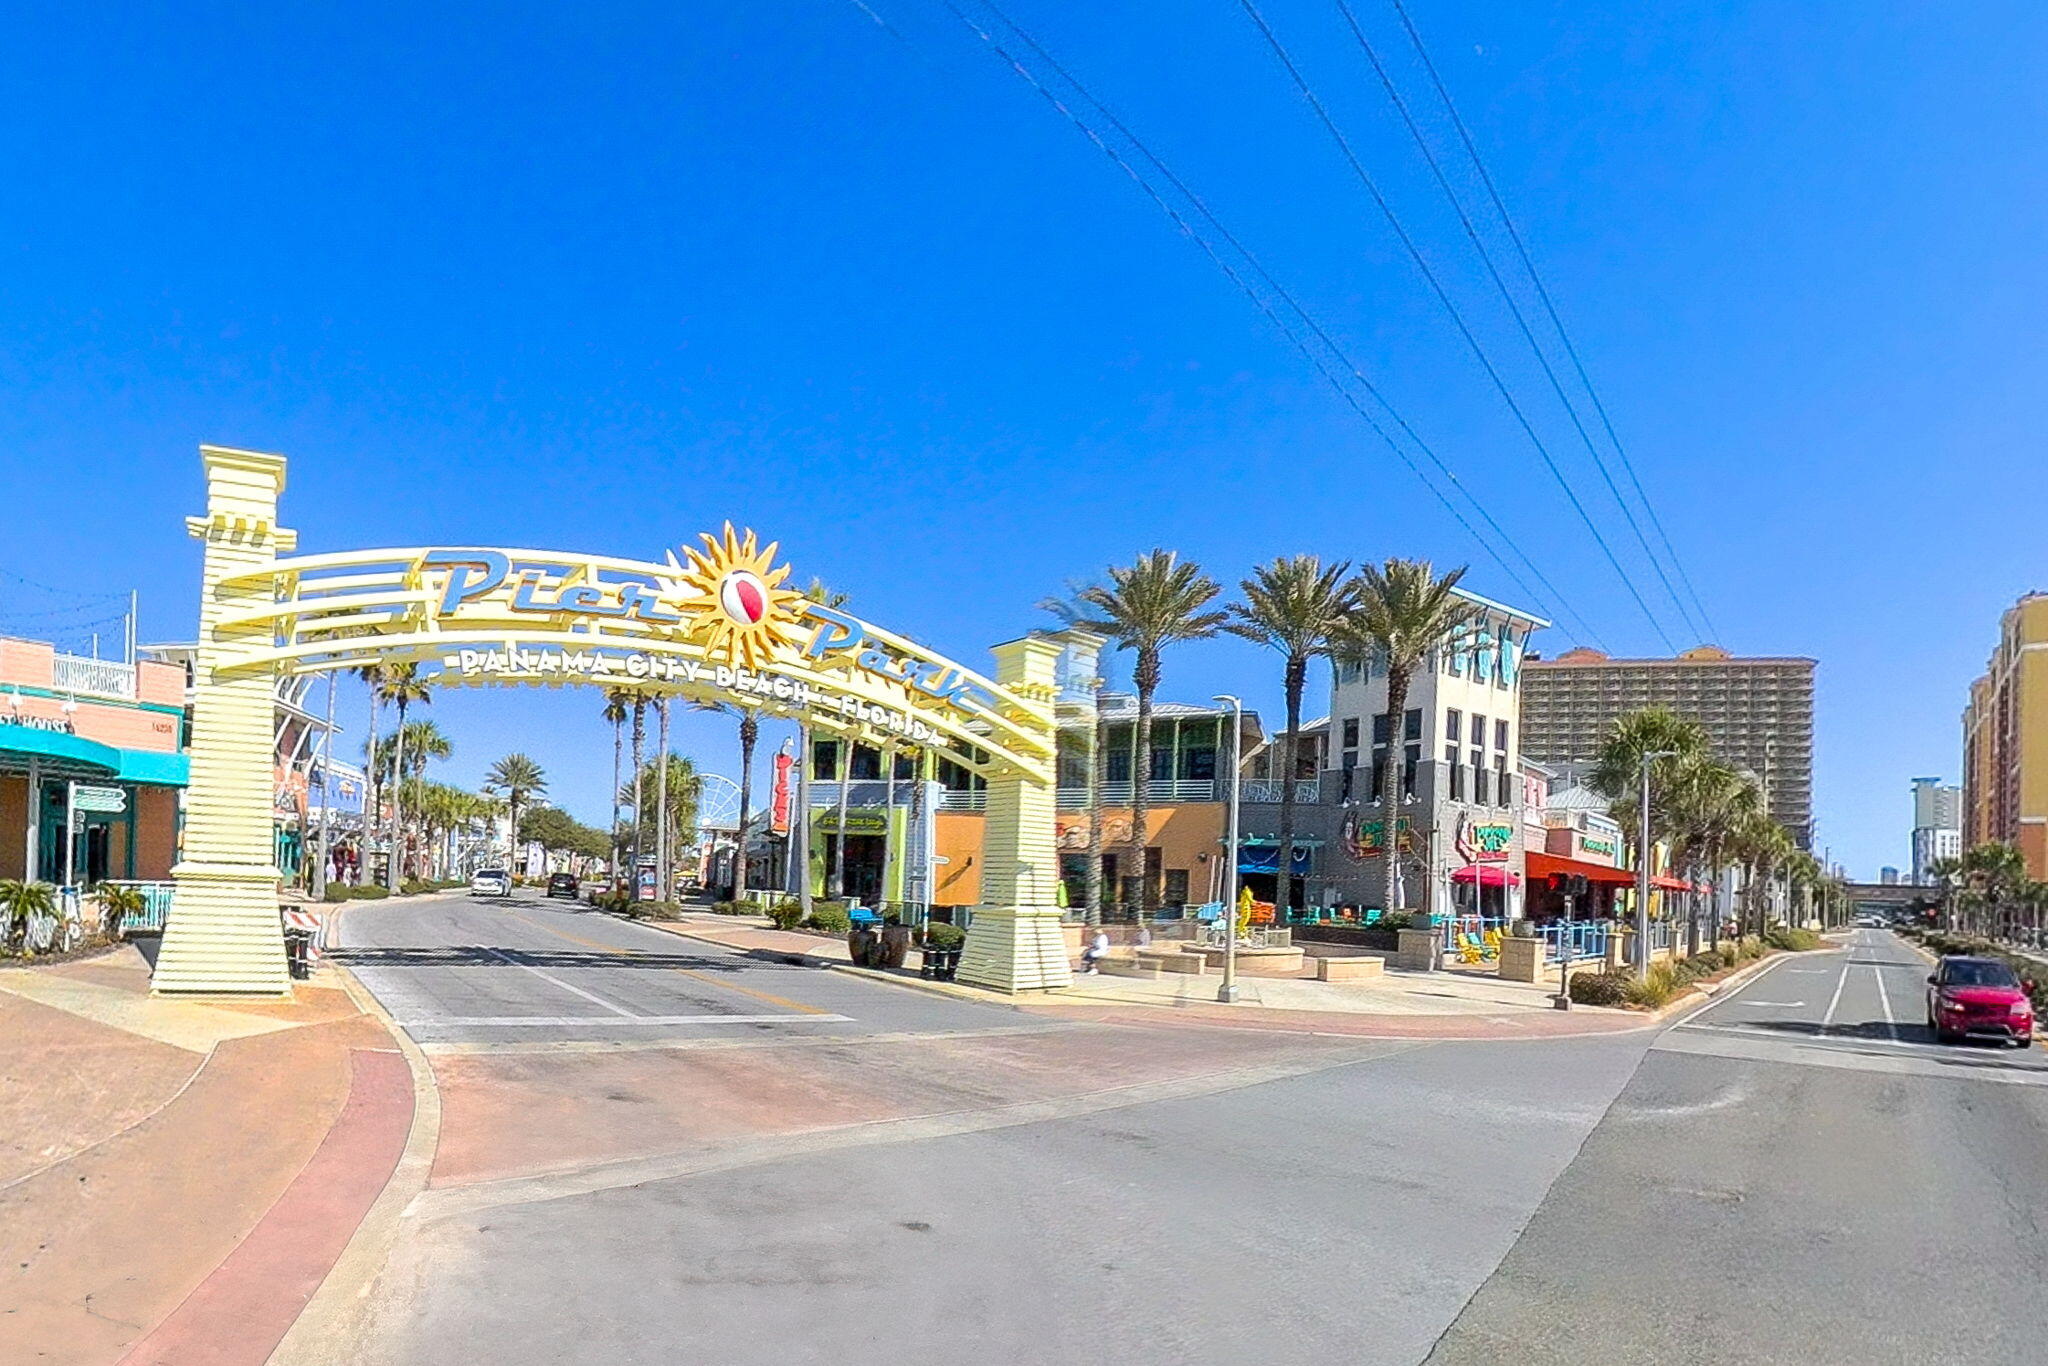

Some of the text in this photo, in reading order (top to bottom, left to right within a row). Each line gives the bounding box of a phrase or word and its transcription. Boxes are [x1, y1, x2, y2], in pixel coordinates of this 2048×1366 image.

[423, 549, 998, 714] Pier Park
[459, 649, 948, 747] PANAMA CITY BEACH FLORIDA
